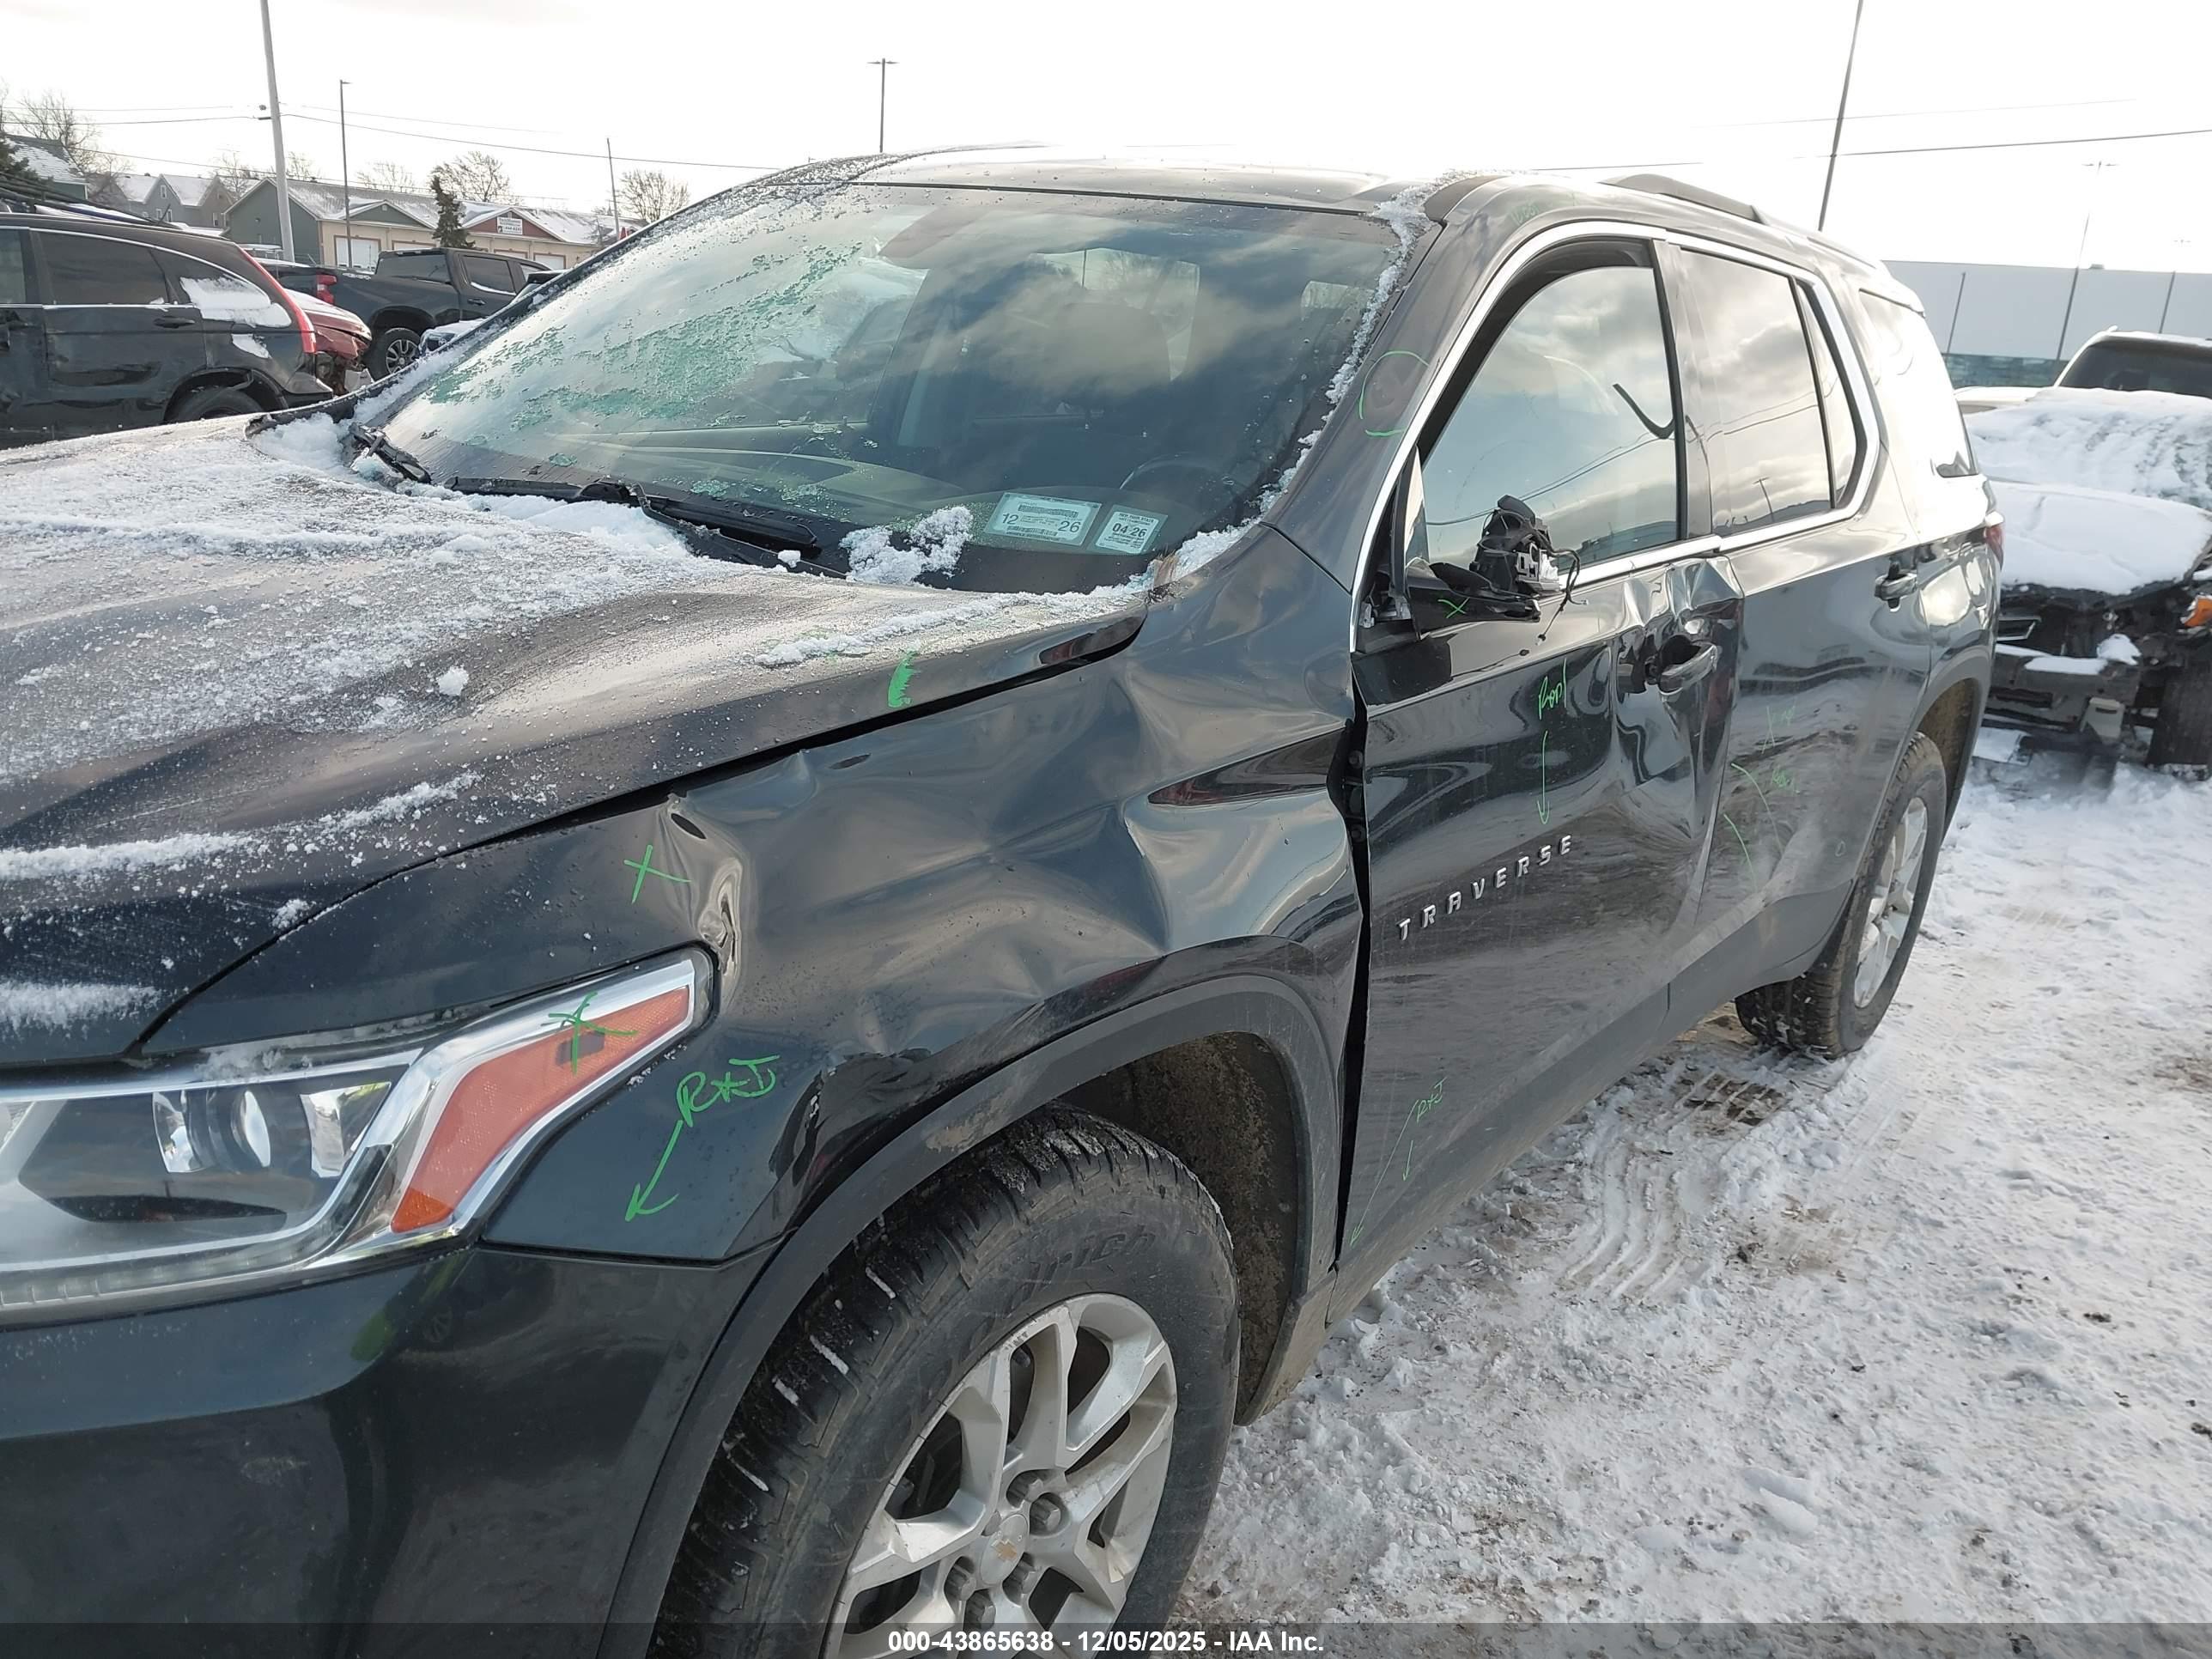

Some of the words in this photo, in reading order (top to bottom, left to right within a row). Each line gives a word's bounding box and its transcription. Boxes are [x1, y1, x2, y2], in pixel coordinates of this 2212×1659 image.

[1002, 513, 1019, 525] 12
[1058, 520, 1081, 533] 26
[1396, 835, 1571, 941] TRAVERSE
